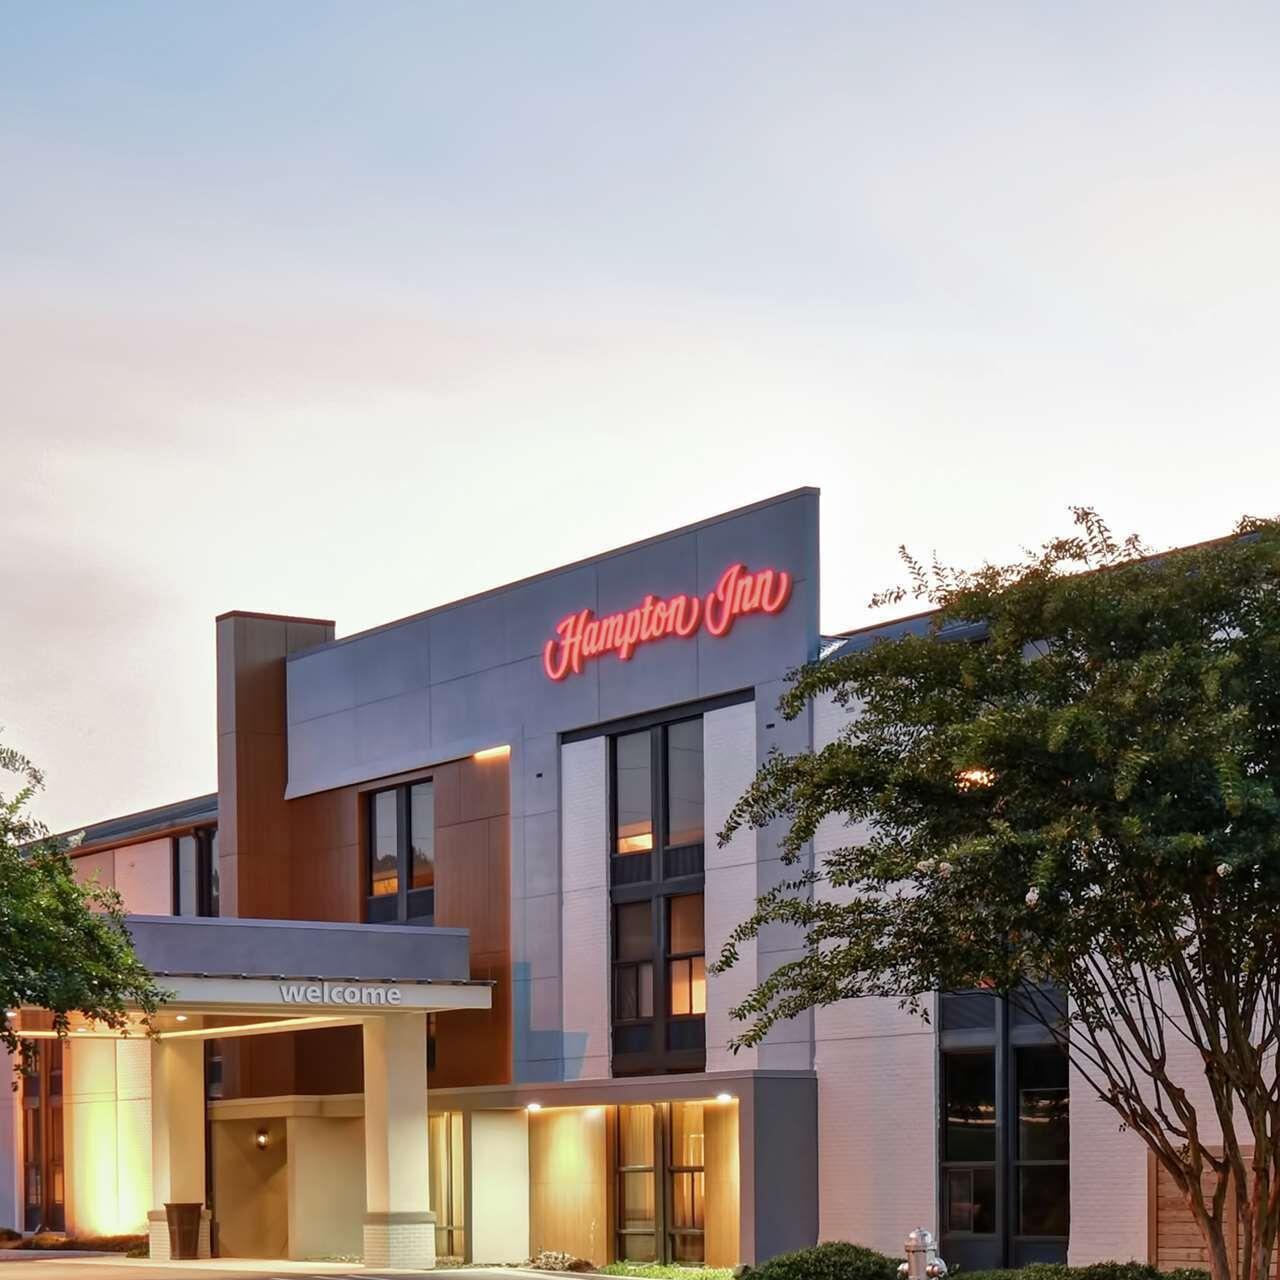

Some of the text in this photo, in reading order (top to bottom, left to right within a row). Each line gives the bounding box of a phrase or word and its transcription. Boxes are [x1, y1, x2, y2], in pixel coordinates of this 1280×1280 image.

[543, 563, 792, 681] Hampton Inn
[280, 982, 401, 1005] welcome
